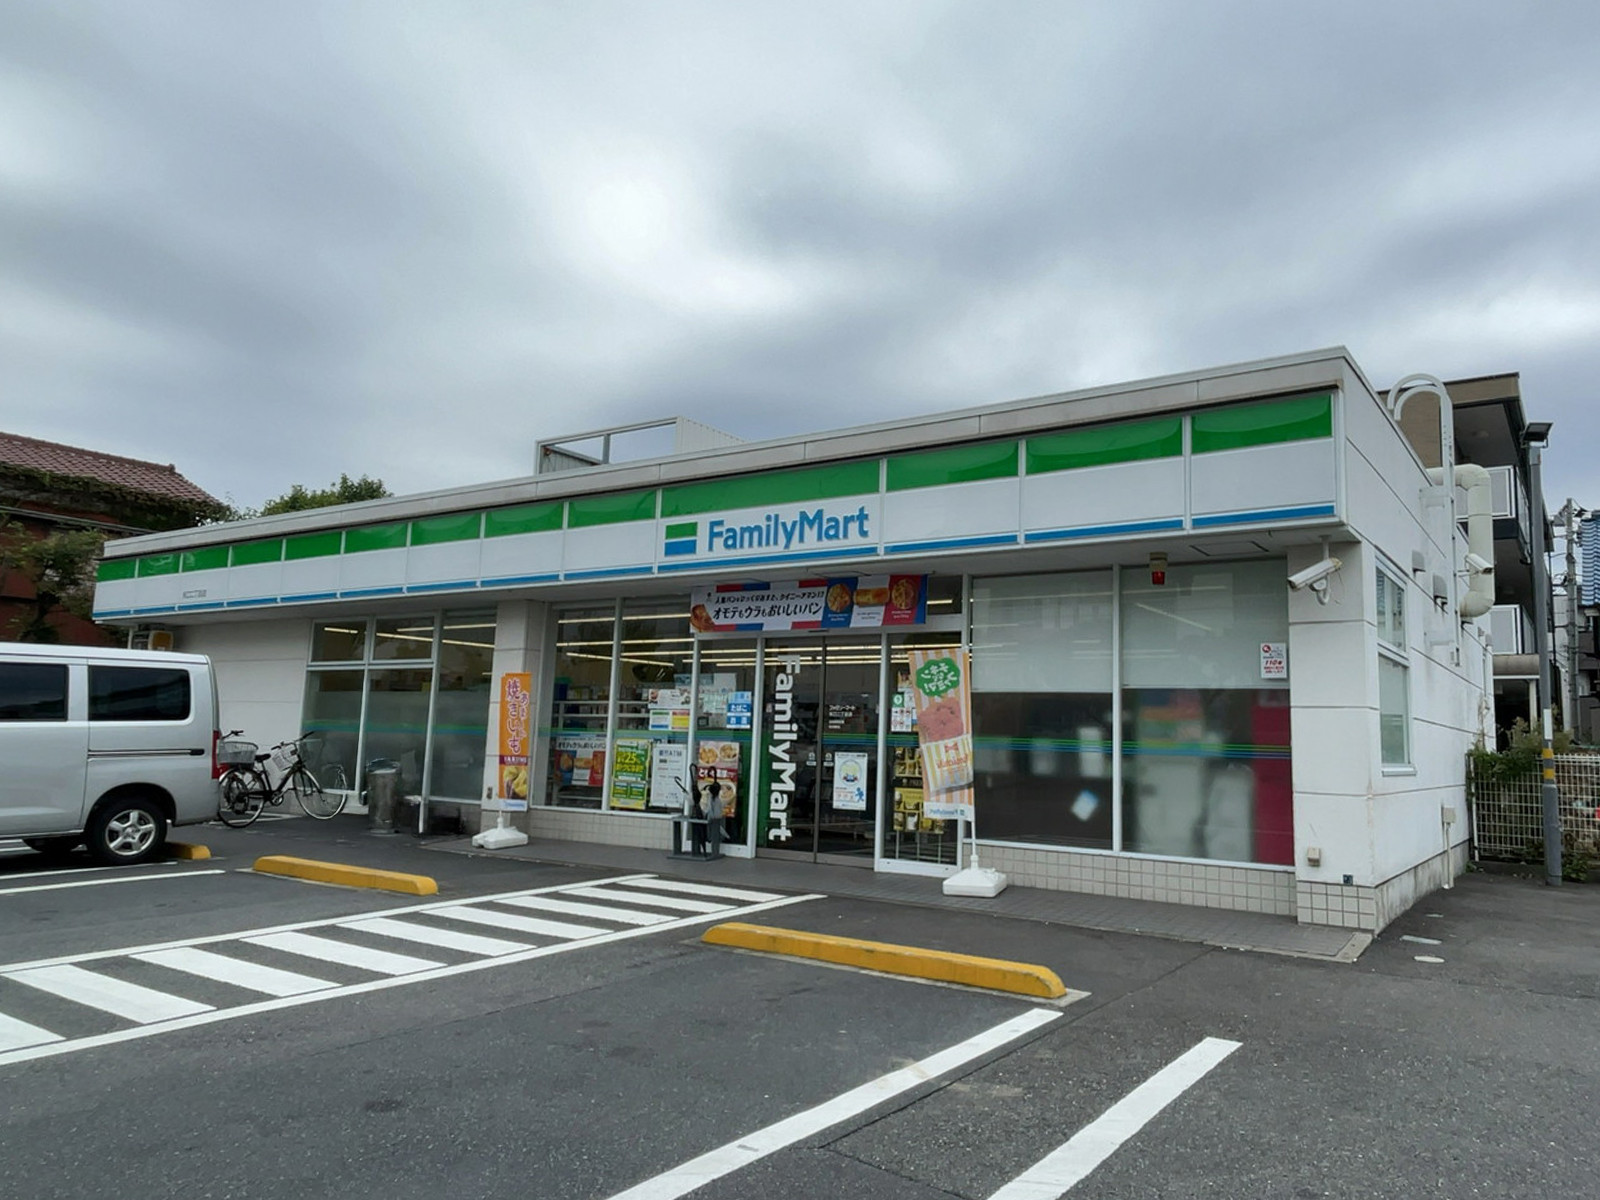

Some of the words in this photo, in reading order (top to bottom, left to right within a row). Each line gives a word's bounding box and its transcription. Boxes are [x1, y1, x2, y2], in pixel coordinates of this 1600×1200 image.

[708, 506, 869, 550] FamilyMart
[713, 602, 823, 619] オモテもウラもおいしいパン
[505, 678, 522, 754] 焼きいも
[730, 704, 748, 712] たばこ
[769, 655, 800, 841] FamilyMart
